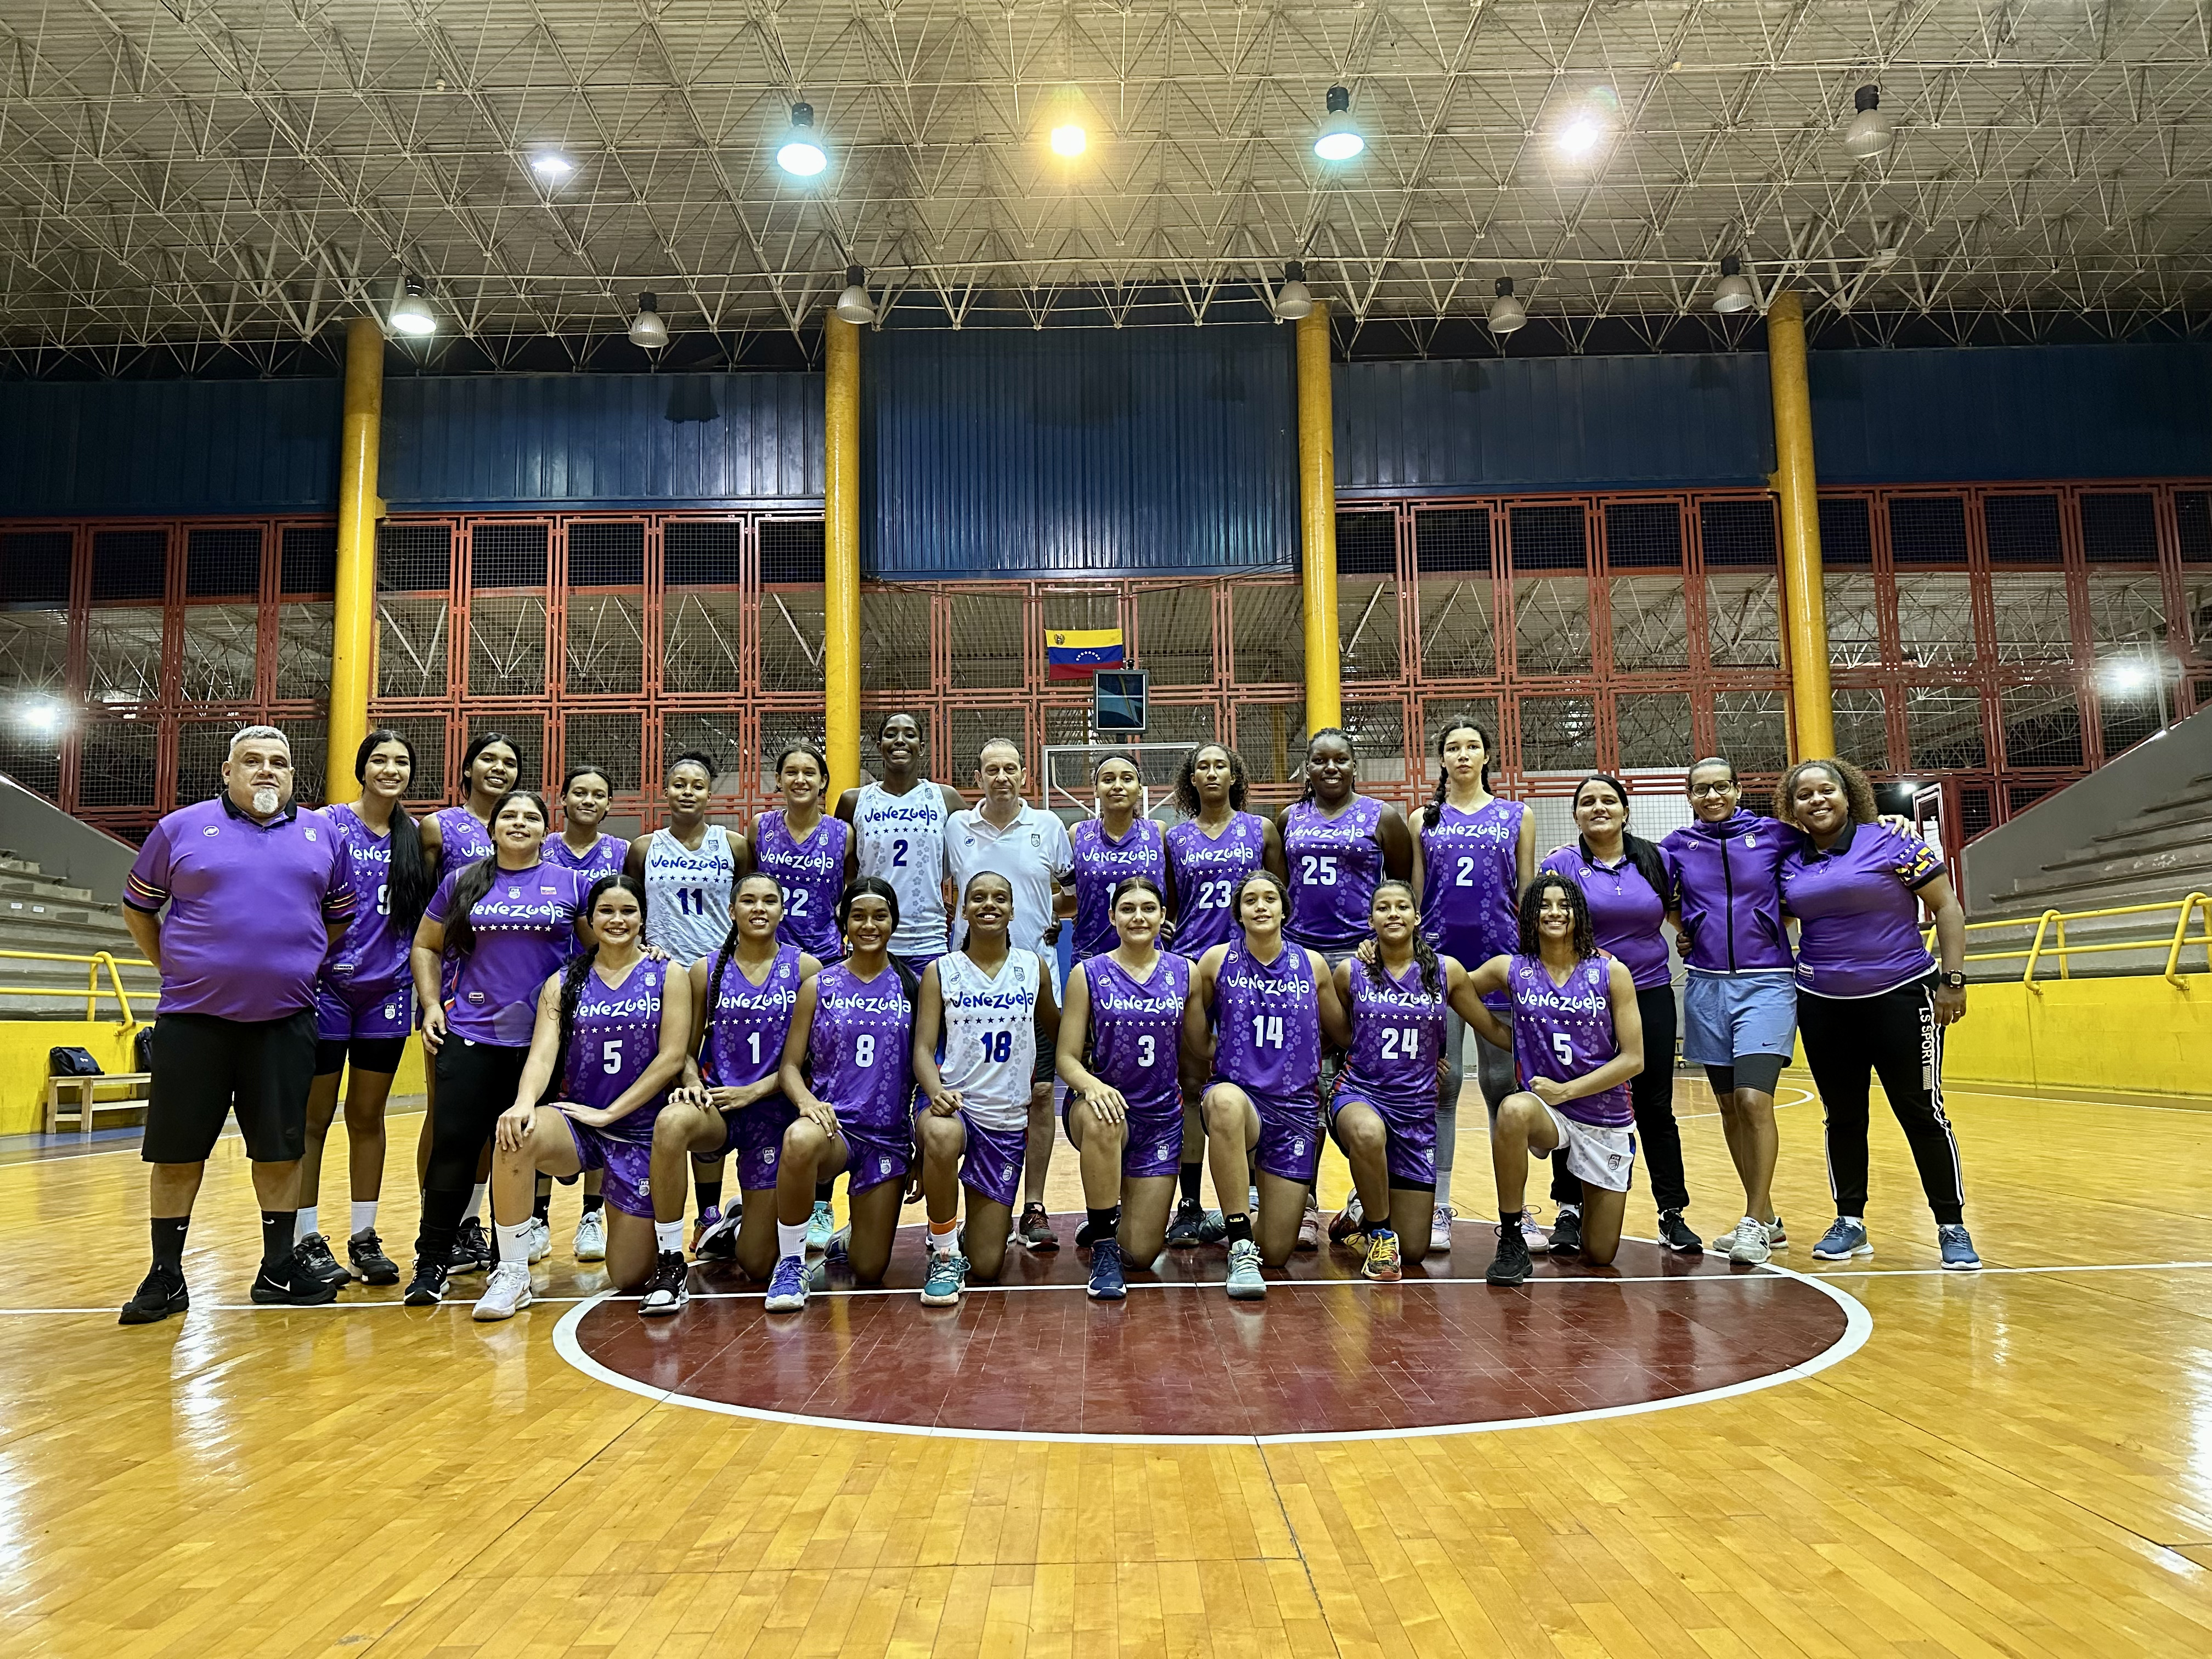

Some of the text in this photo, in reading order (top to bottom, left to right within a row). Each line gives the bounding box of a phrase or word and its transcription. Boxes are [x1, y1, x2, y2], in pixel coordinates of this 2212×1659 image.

[893, 839, 909, 867] 2
[1301, 855, 1337, 885] 25
[1455, 856, 1474, 887] 2
[675, 888, 707, 916] 11
[1199, 880, 1232, 909] 23
[980, 1030, 1012, 1063] 18
[1252, 1015, 1284, 1049] 14
[1381, 1028, 1419, 1059] 24
[1918, 1007, 1933, 1065] LS SPORT
[603, 1040, 623, 1074] 5
[747, 1032, 760, 1064] 1
[855, 1034, 875, 1068] 8
[1138, 1035, 1155, 1066] 3
[1553, 1032, 1572, 1065] 5
